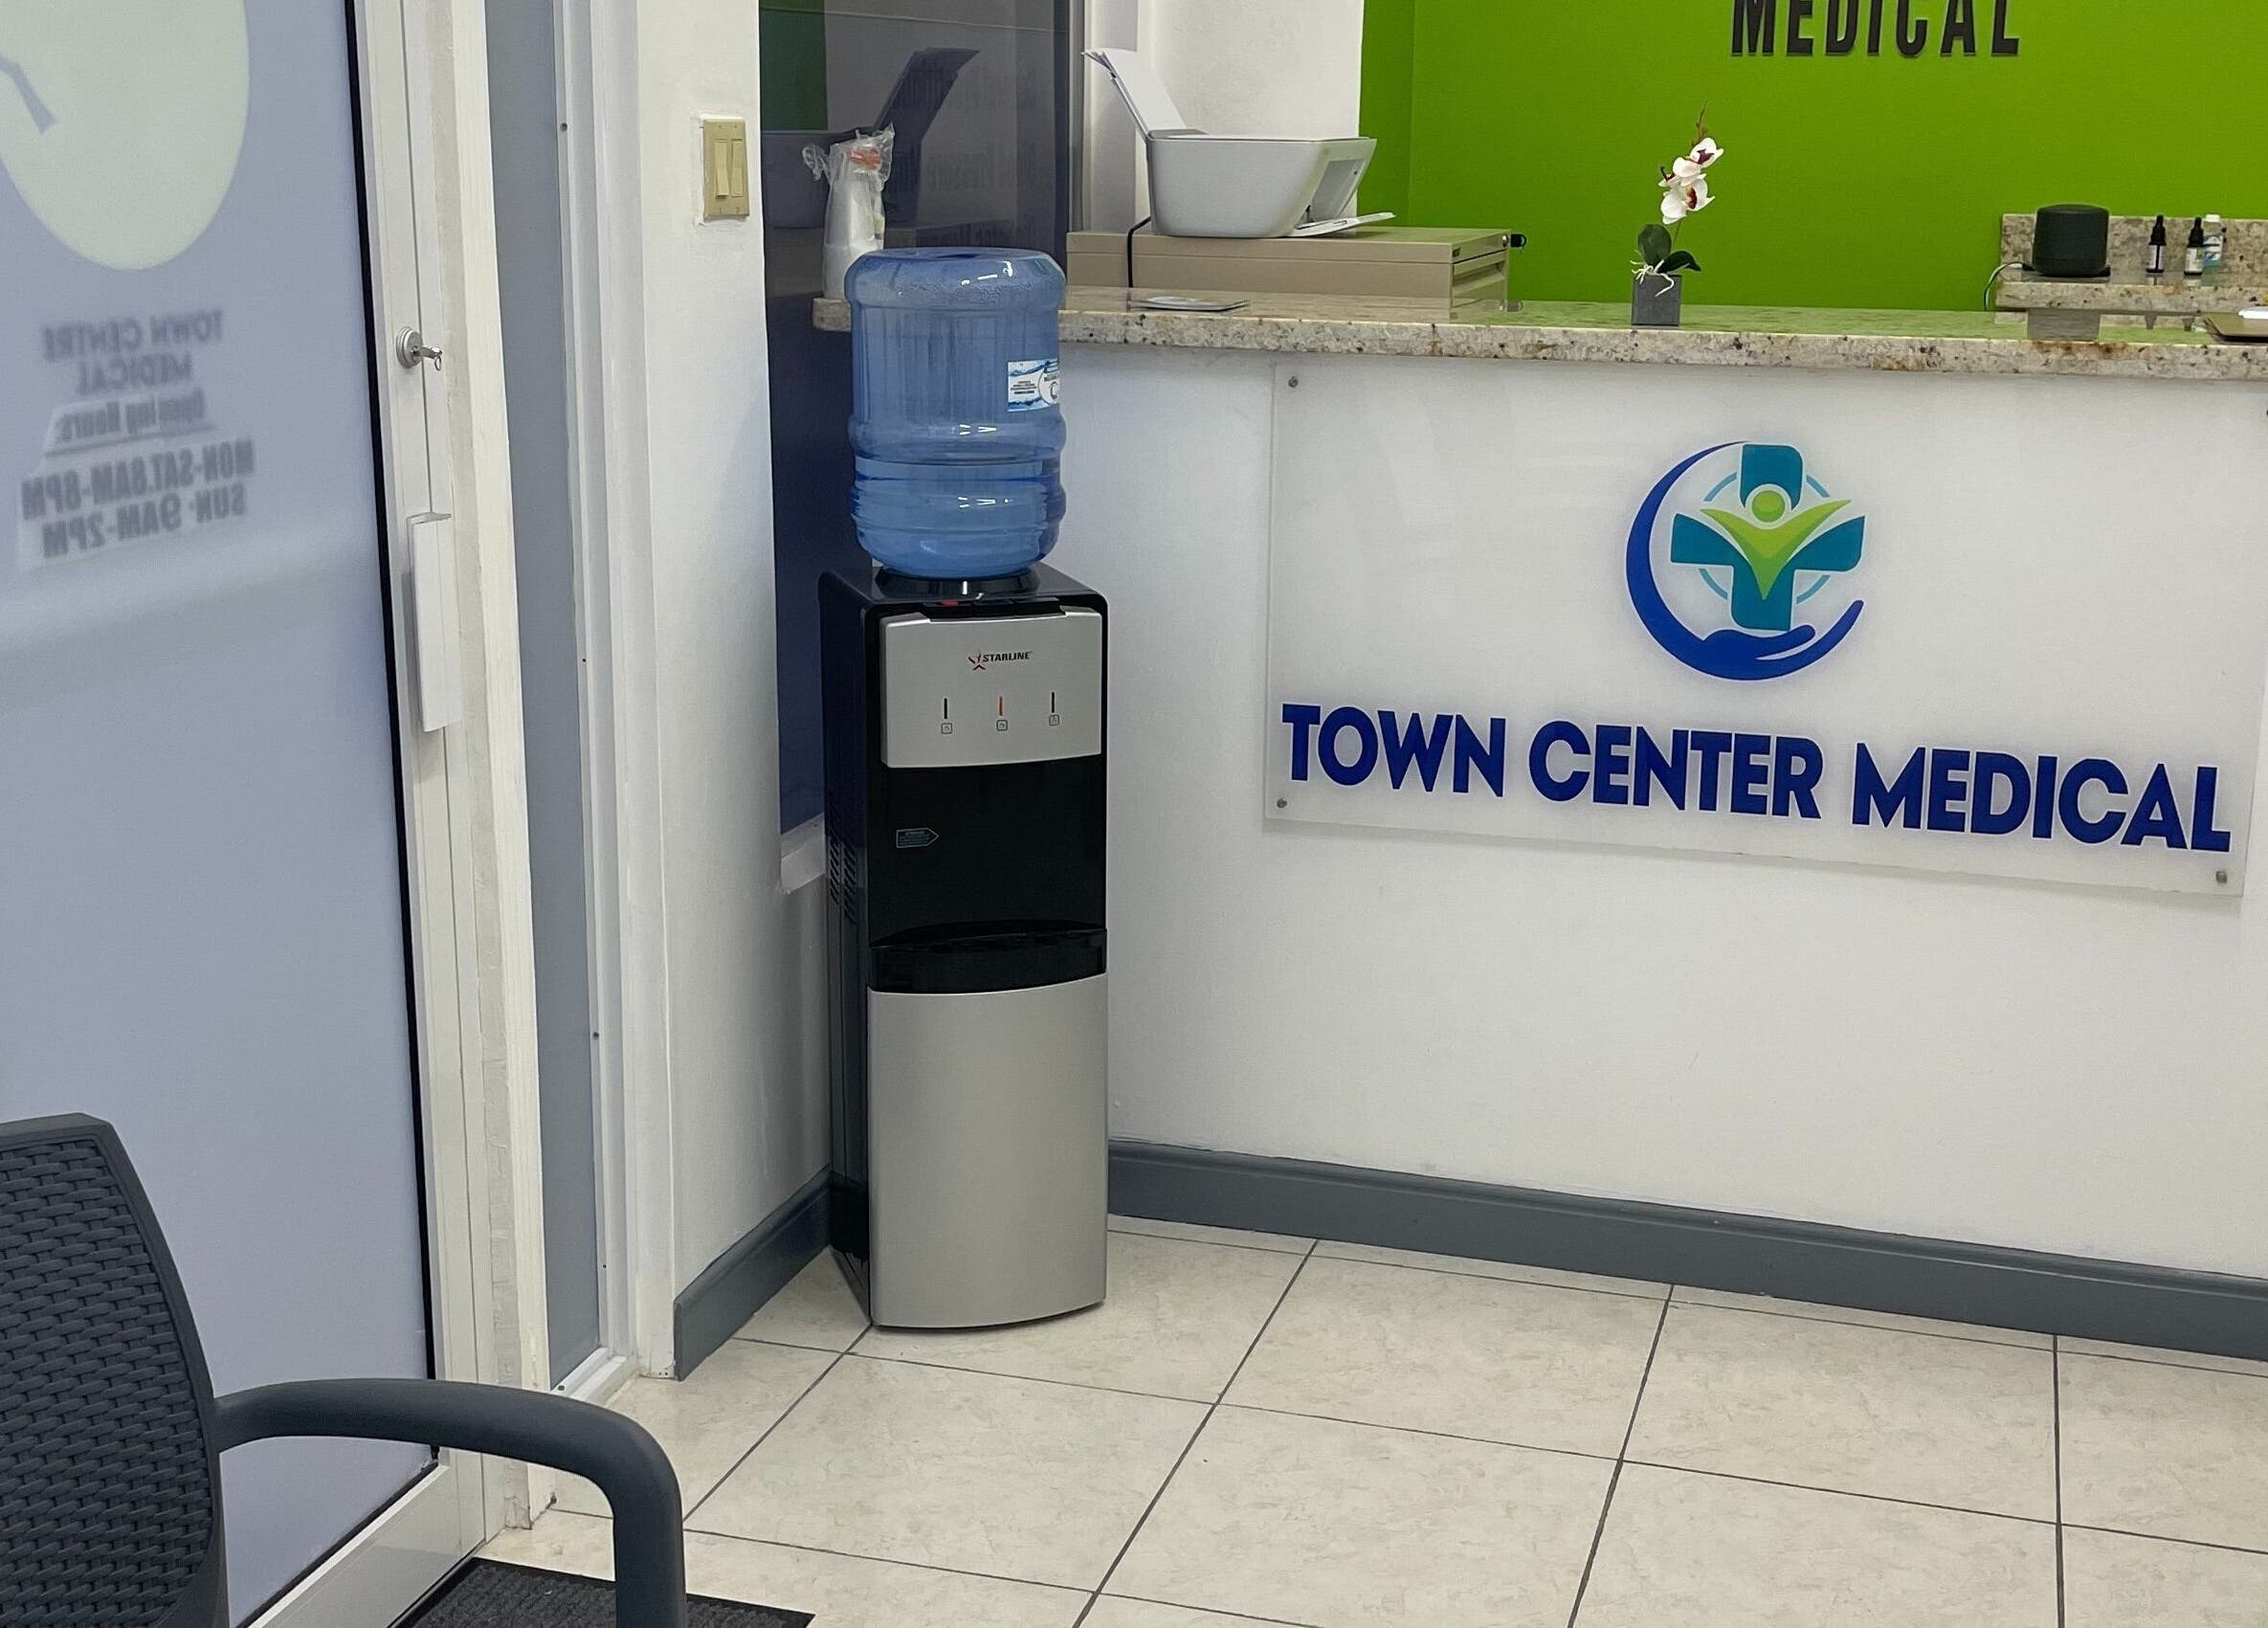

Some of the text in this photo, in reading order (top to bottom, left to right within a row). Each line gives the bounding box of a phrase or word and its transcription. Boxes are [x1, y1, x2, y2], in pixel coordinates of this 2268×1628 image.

[1731, 0, 2020, 56] MEDICAL
[983, 652, 1032, 662] STARLINE
[1282, 703, 2232, 853] TOWN CENTER MEDICAL
